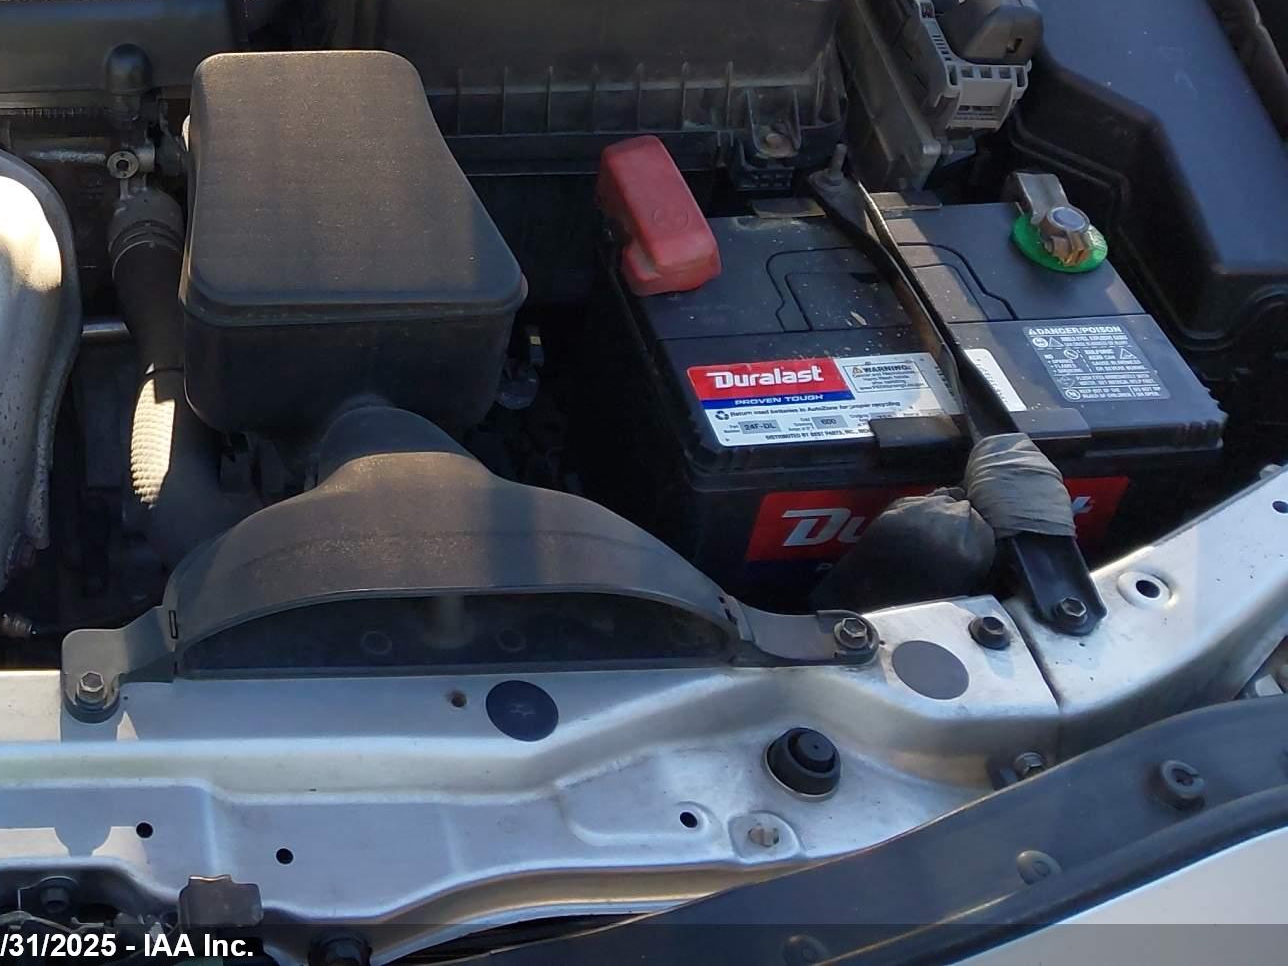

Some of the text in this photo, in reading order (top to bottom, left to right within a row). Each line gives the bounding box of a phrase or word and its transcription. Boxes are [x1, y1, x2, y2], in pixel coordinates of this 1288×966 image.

[1036, 326, 1122, 335] DANGER/POISON
[706, 365, 825, 389] Duralast
[734, 394, 824, 405] PROVEN TOUGH
[743, 422, 777, 431] 24F-DL
